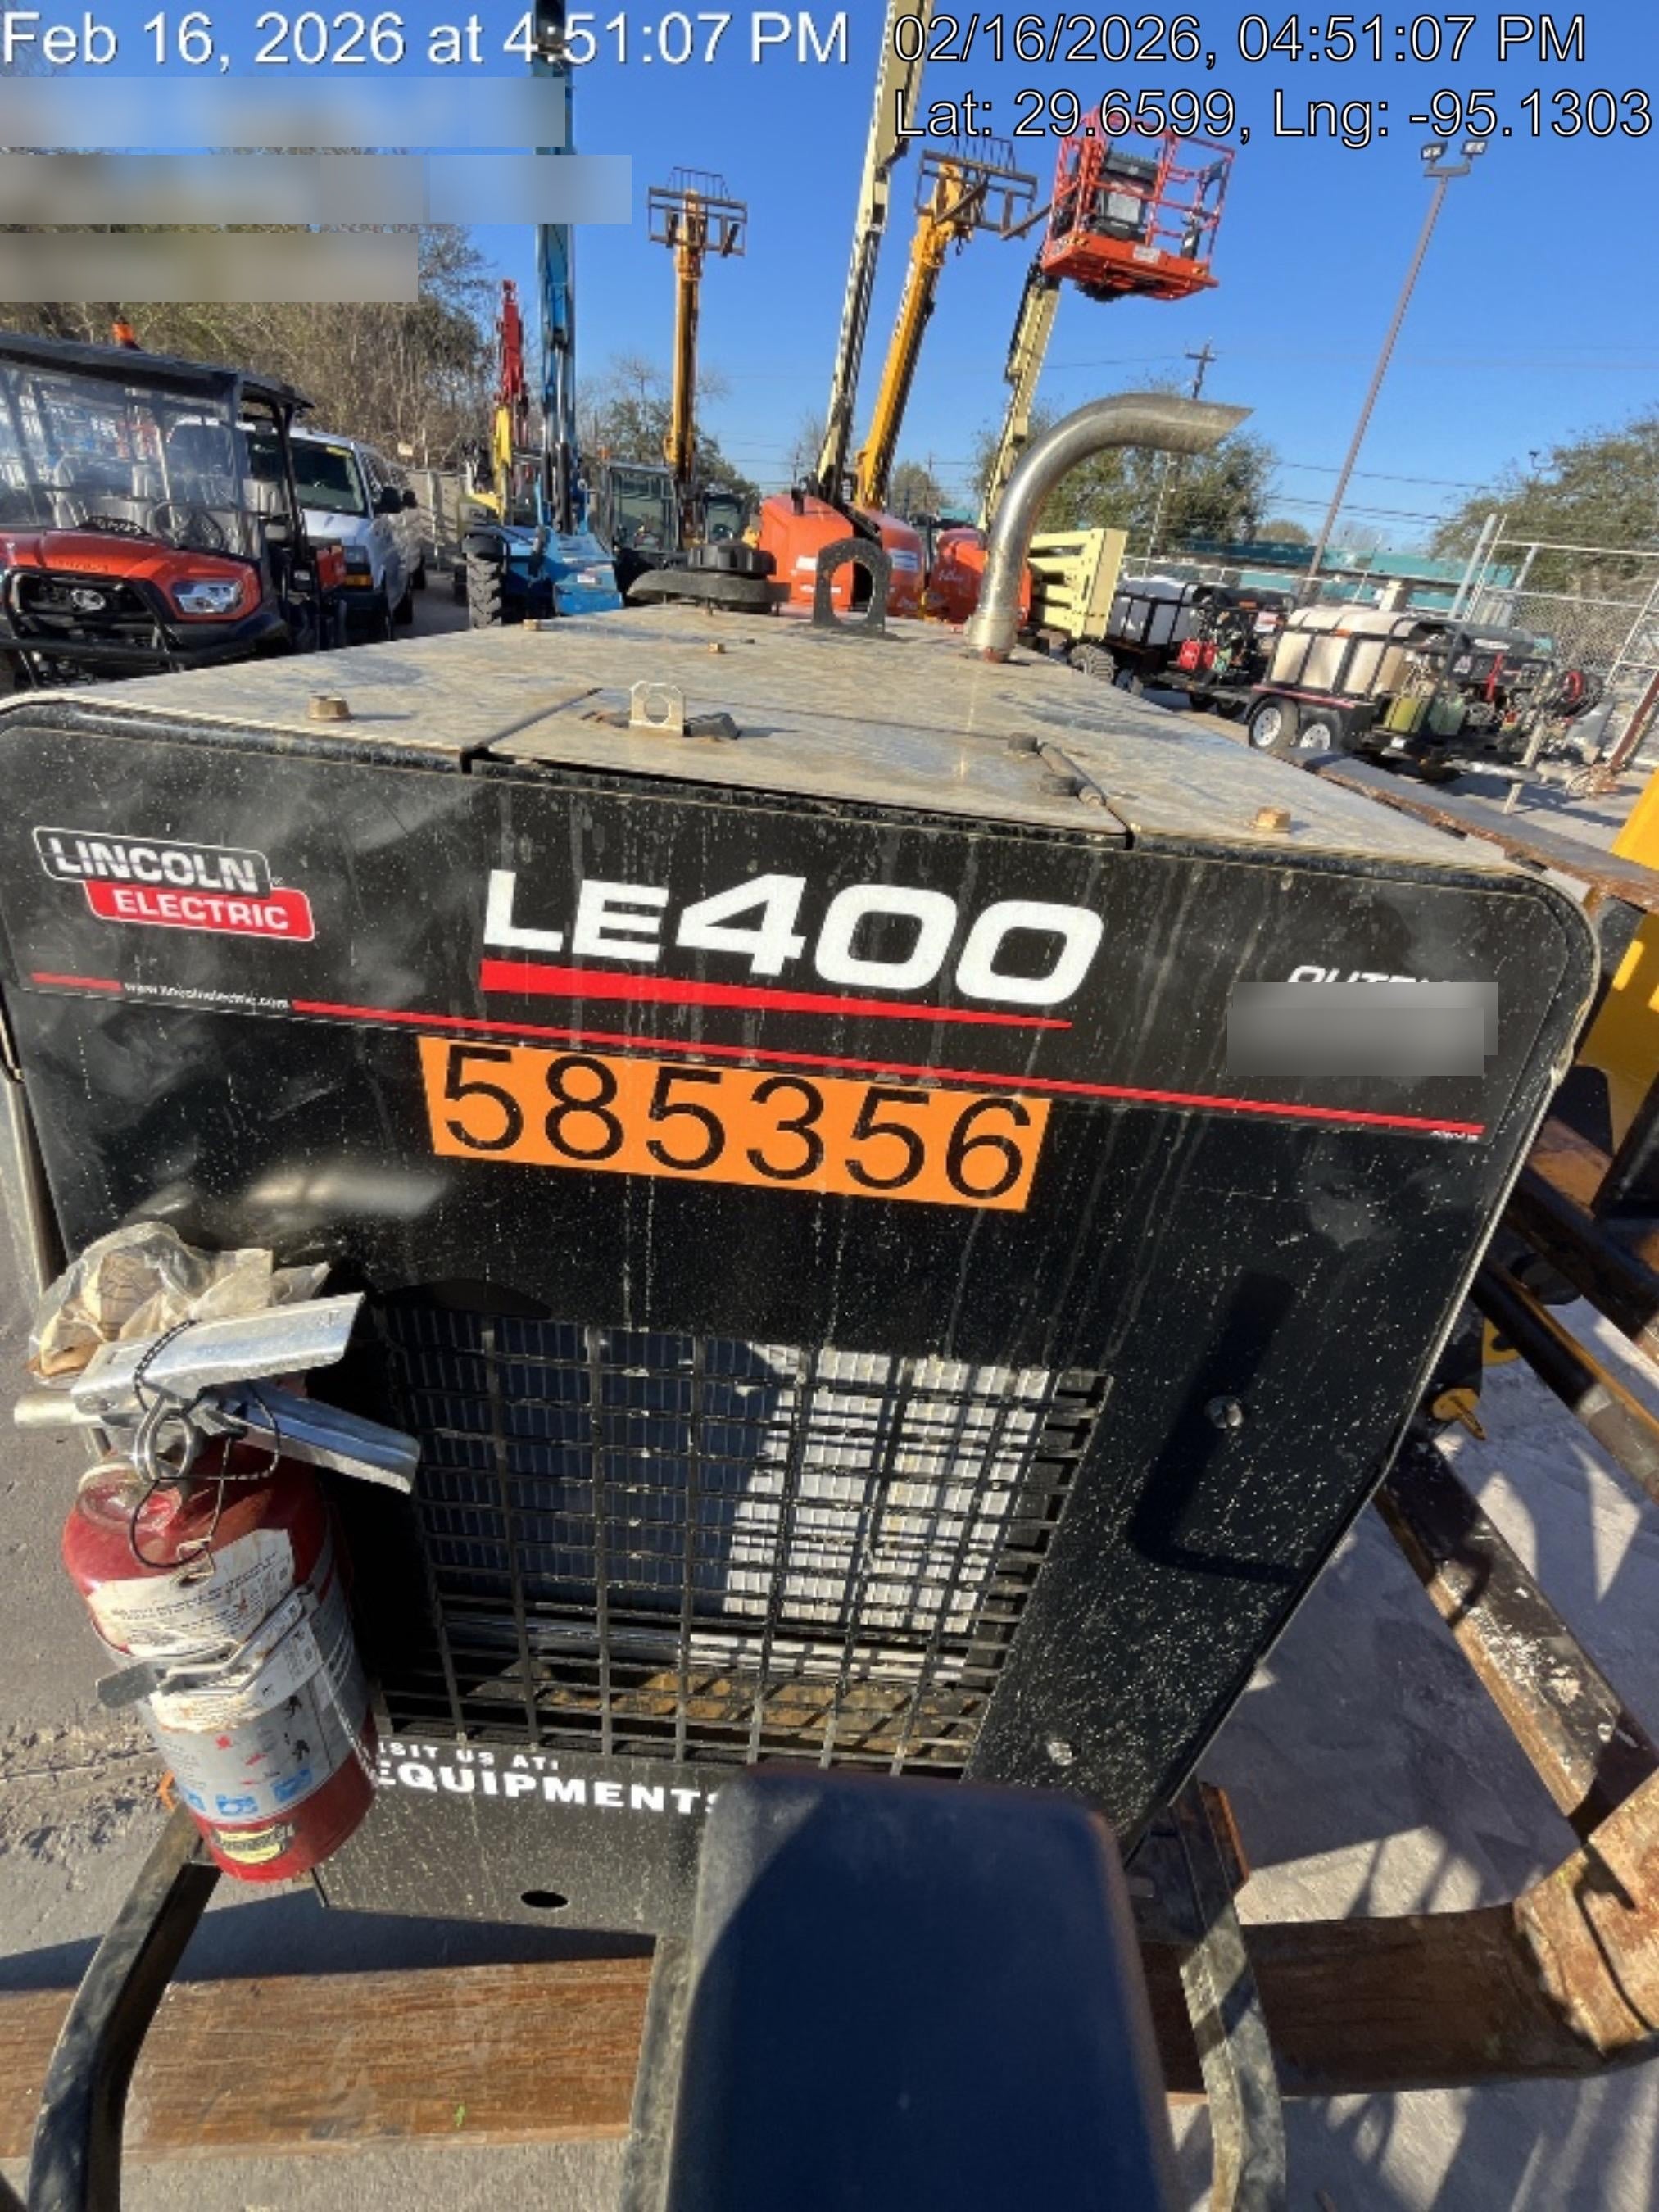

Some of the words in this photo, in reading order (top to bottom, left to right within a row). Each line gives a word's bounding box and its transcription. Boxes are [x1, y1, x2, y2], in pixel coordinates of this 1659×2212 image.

[48, 837, 259, 893] LINCOLN
[113, 888, 289, 931] ELECTRIC
[483, 869, 1104, 1005] LE400
[443, 1043, 1033, 1201] 585356
[378, 1742, 439, 1760] ISIT
[456, 1749, 496, 1766] US
